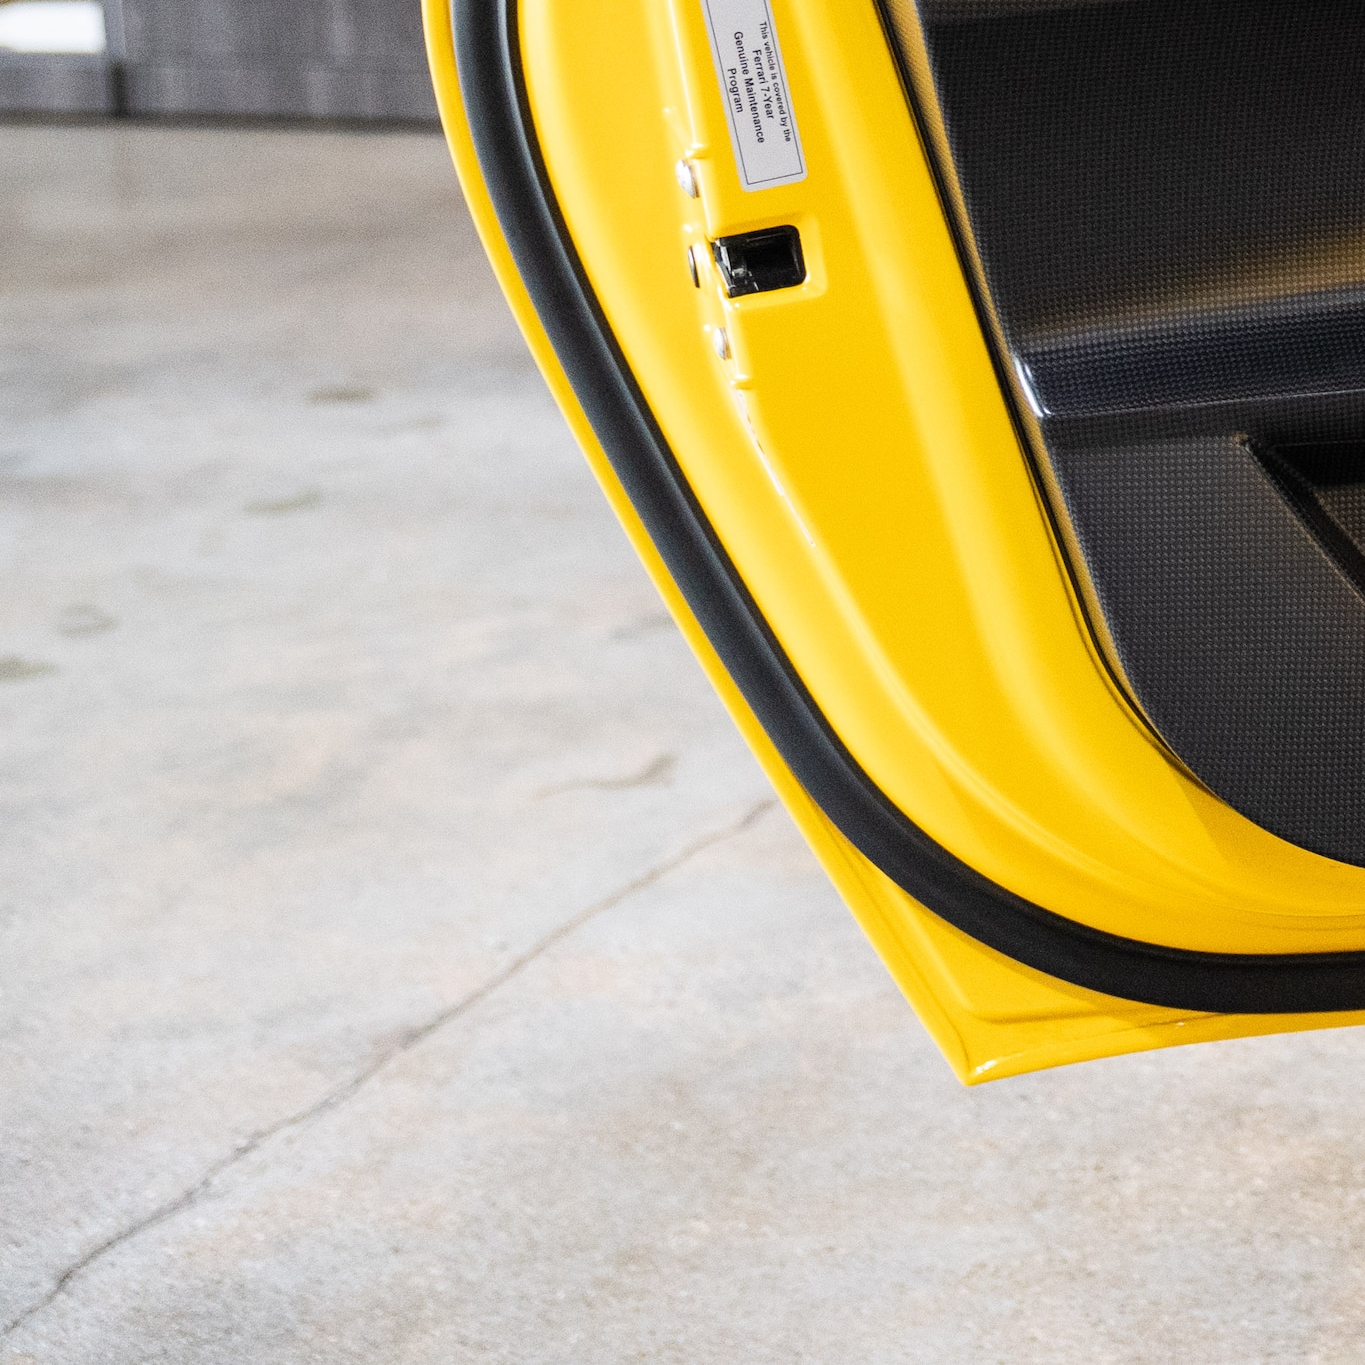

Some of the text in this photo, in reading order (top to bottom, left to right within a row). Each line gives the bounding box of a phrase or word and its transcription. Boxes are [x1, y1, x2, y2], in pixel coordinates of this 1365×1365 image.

[727, 68, 743, 113] Program
[734, 31, 765, 143] Genuine Maintenance
[752, 49, 775, 119] Ferrari 7-Year
[760, 21, 791, 142] This vehicle is covered by the
